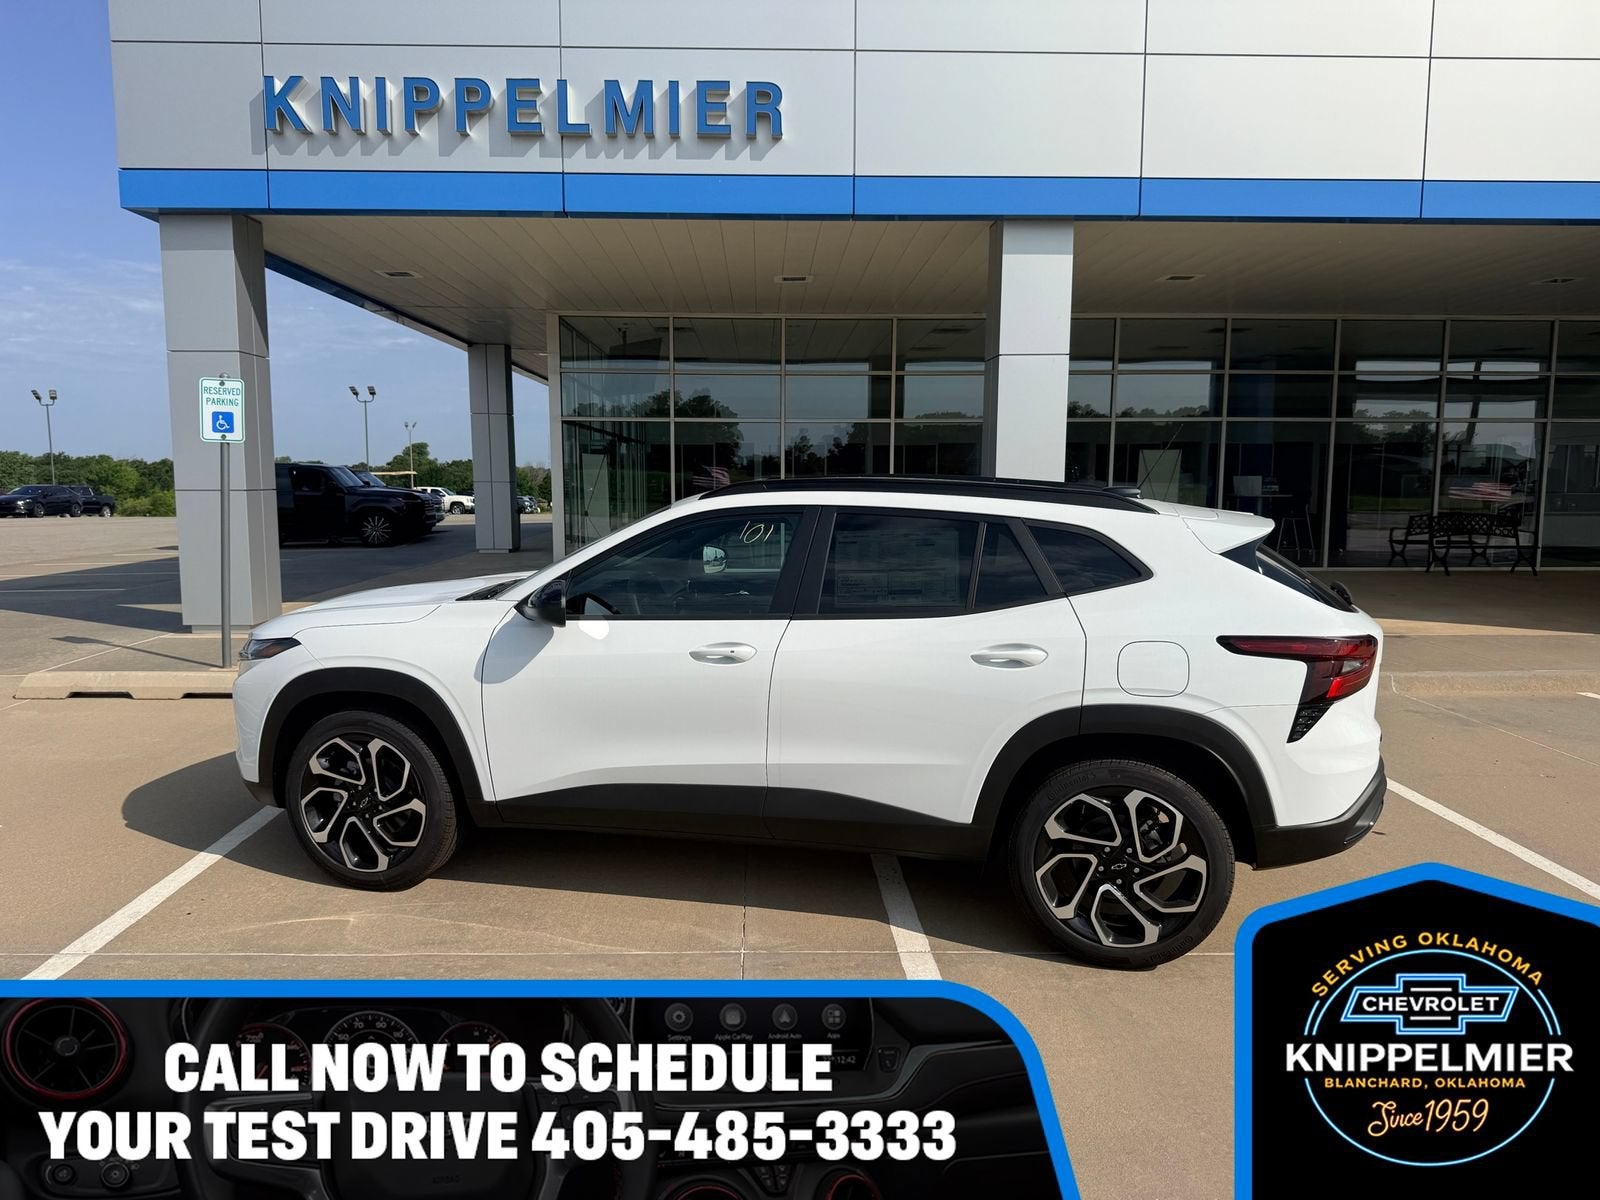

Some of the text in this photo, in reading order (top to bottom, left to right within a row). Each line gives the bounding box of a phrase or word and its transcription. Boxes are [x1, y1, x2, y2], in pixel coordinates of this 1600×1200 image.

[263, 75, 784, 138] KNIPPELMIER
[203, 386, 242, 396] RESERVED
[205, 397, 240, 407] PARKING
[739, 520, 774, 544] 101
